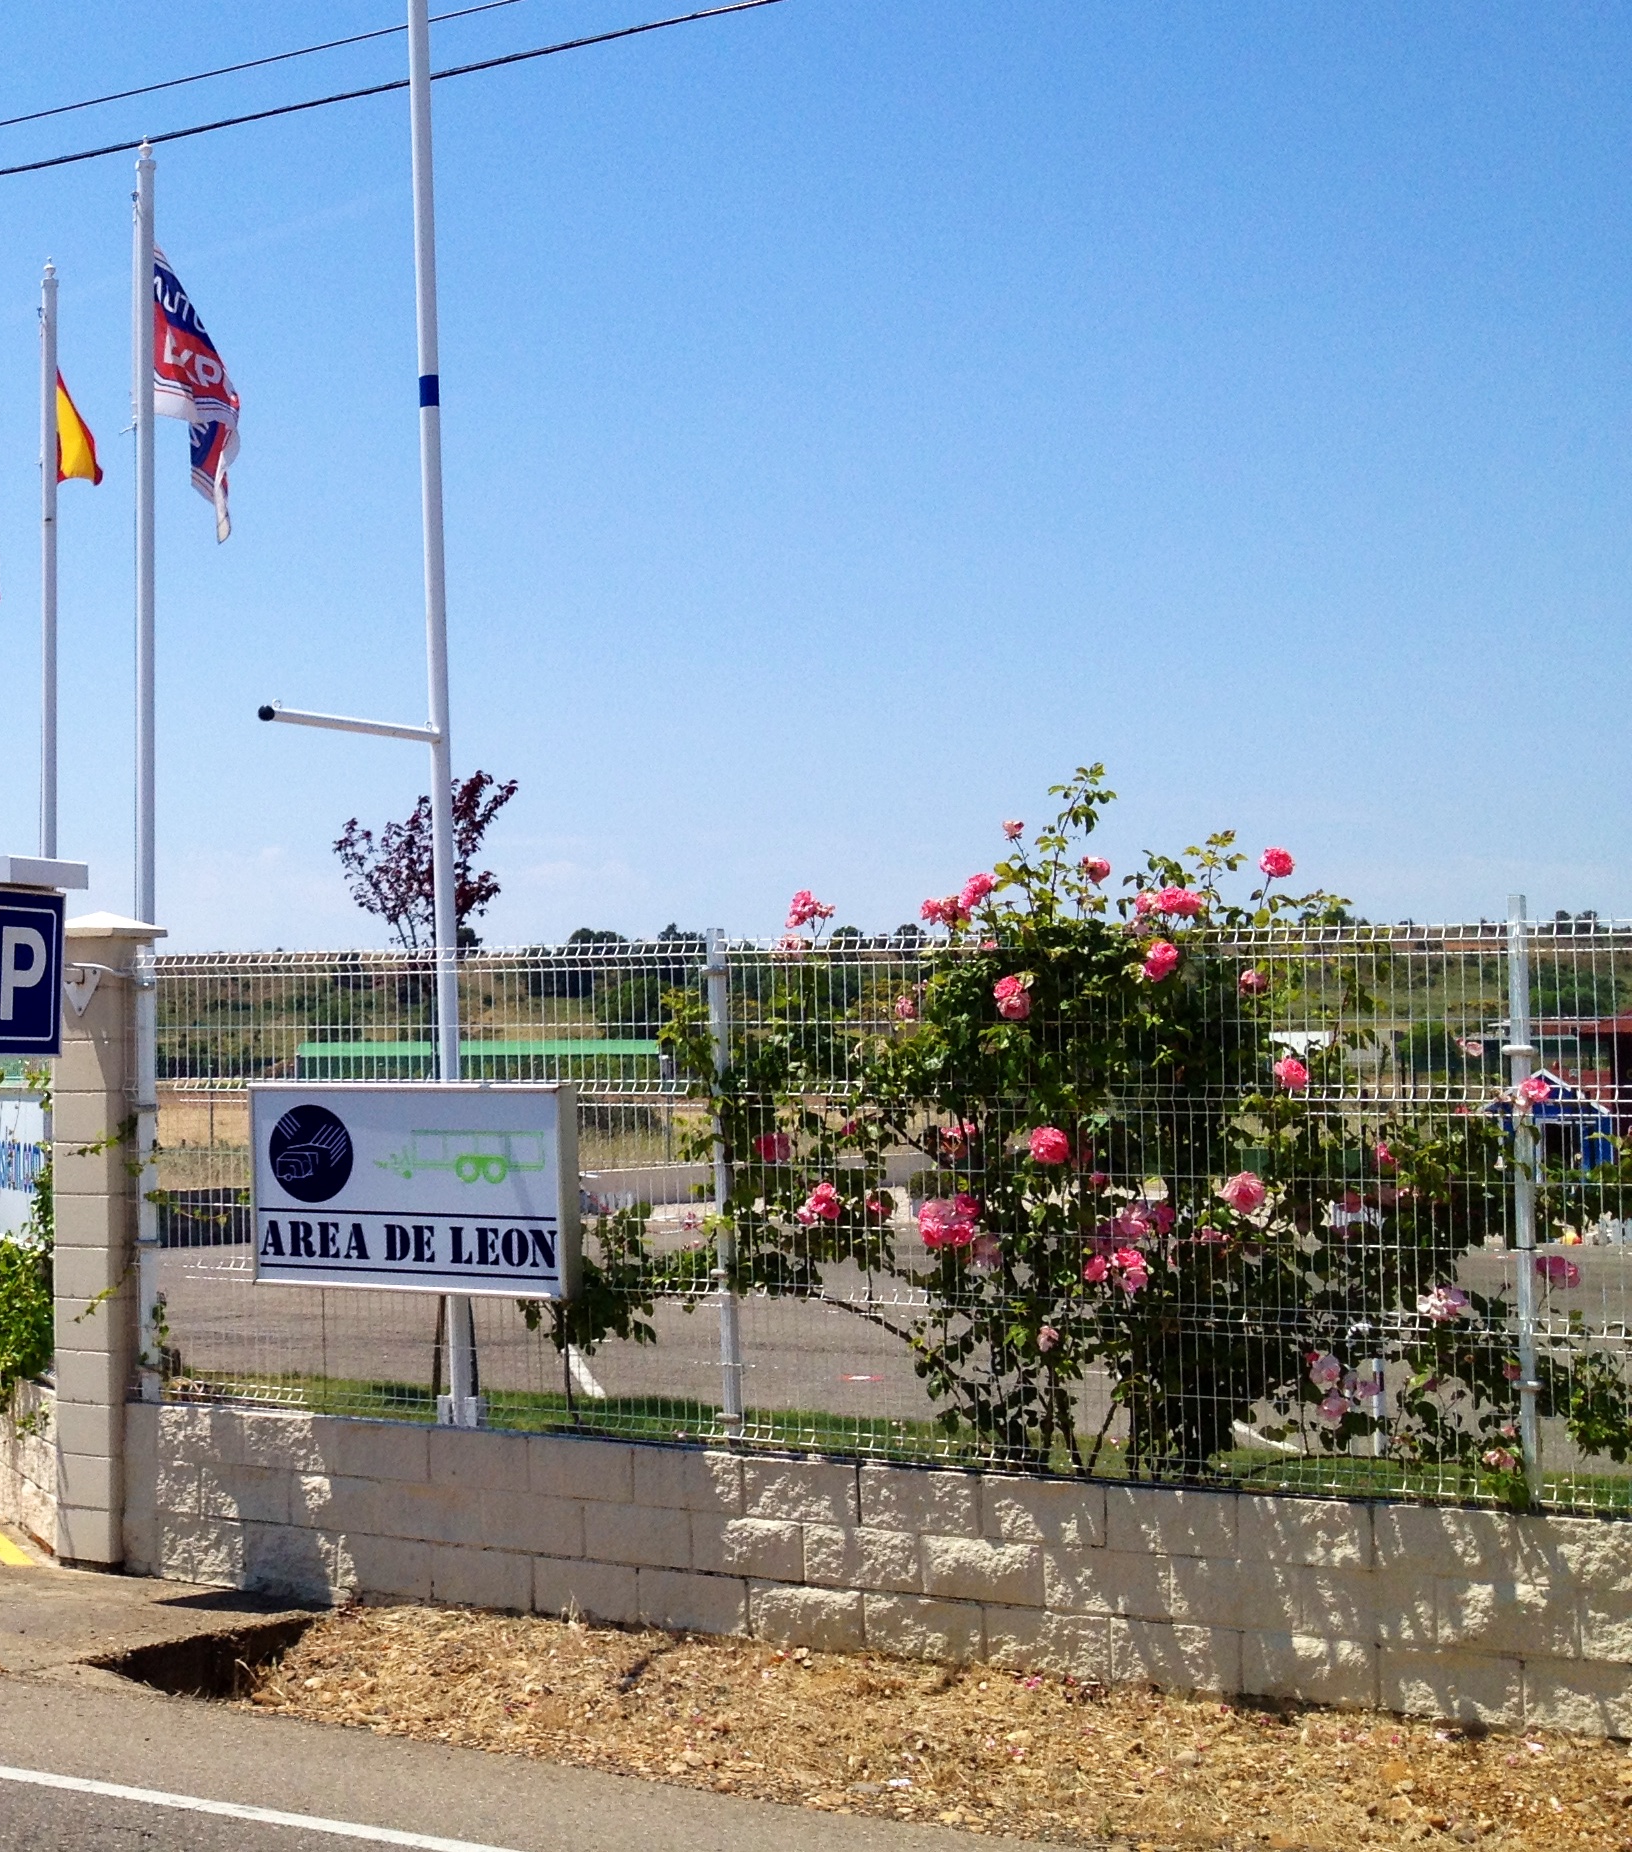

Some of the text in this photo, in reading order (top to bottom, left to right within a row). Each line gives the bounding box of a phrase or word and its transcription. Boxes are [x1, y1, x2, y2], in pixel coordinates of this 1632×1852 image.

[0, 925, 47, 1021] P
[260, 1220, 558, 1269] AREA DE LEON
